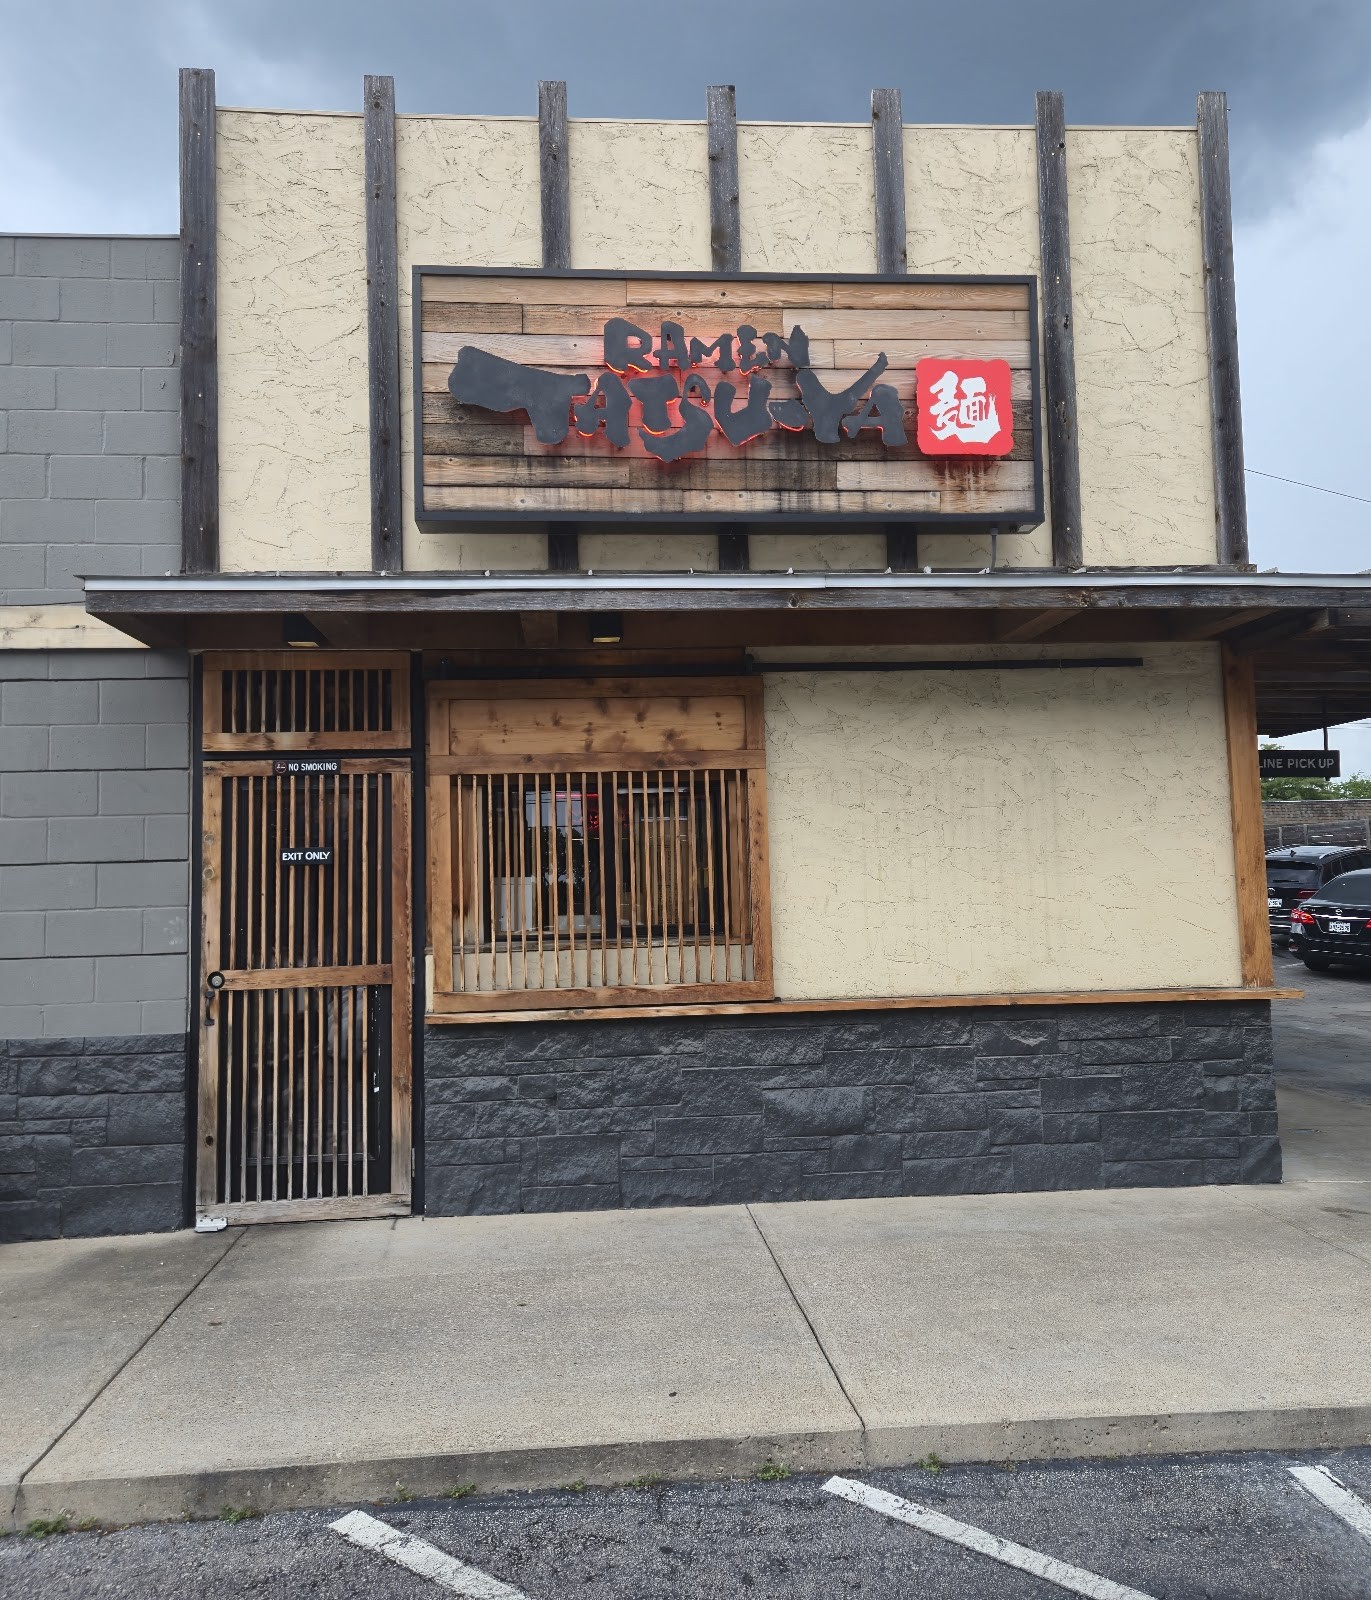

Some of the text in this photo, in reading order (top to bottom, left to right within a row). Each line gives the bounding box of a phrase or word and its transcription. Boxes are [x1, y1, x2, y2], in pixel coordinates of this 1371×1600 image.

[604, 317, 810, 373] RAMEN
[288, 762, 338, 771] NO SMOKING
[1287, 758, 1316, 769] PICK
[1318, 758, 1335, 769] UP
[282, 851, 331, 861] EXIT ONLY
